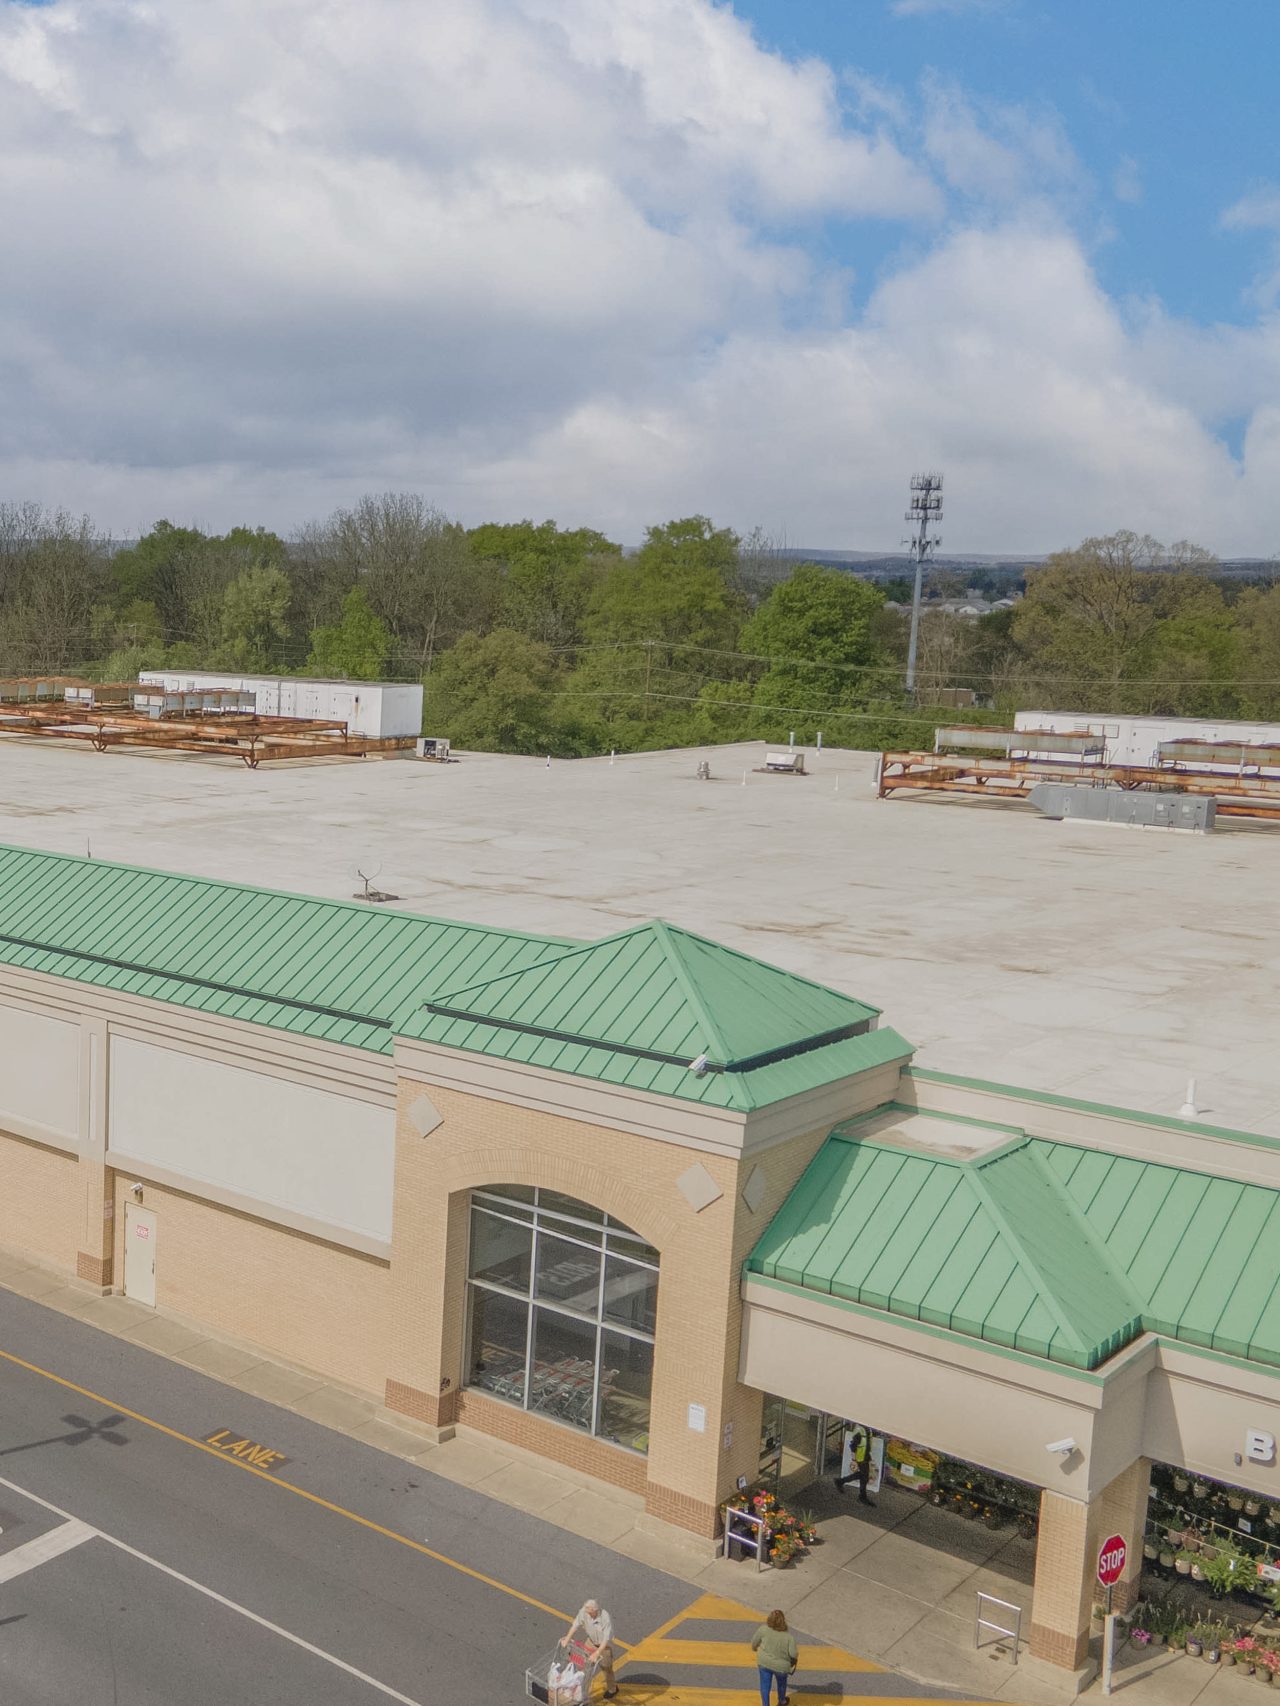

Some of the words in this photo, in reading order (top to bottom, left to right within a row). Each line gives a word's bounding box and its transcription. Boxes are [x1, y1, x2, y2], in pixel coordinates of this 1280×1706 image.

[206, 1430, 286, 1469] LANE
[1246, 1428, 1276, 1462] B
[1100, 1547, 1125, 1574] STOP
